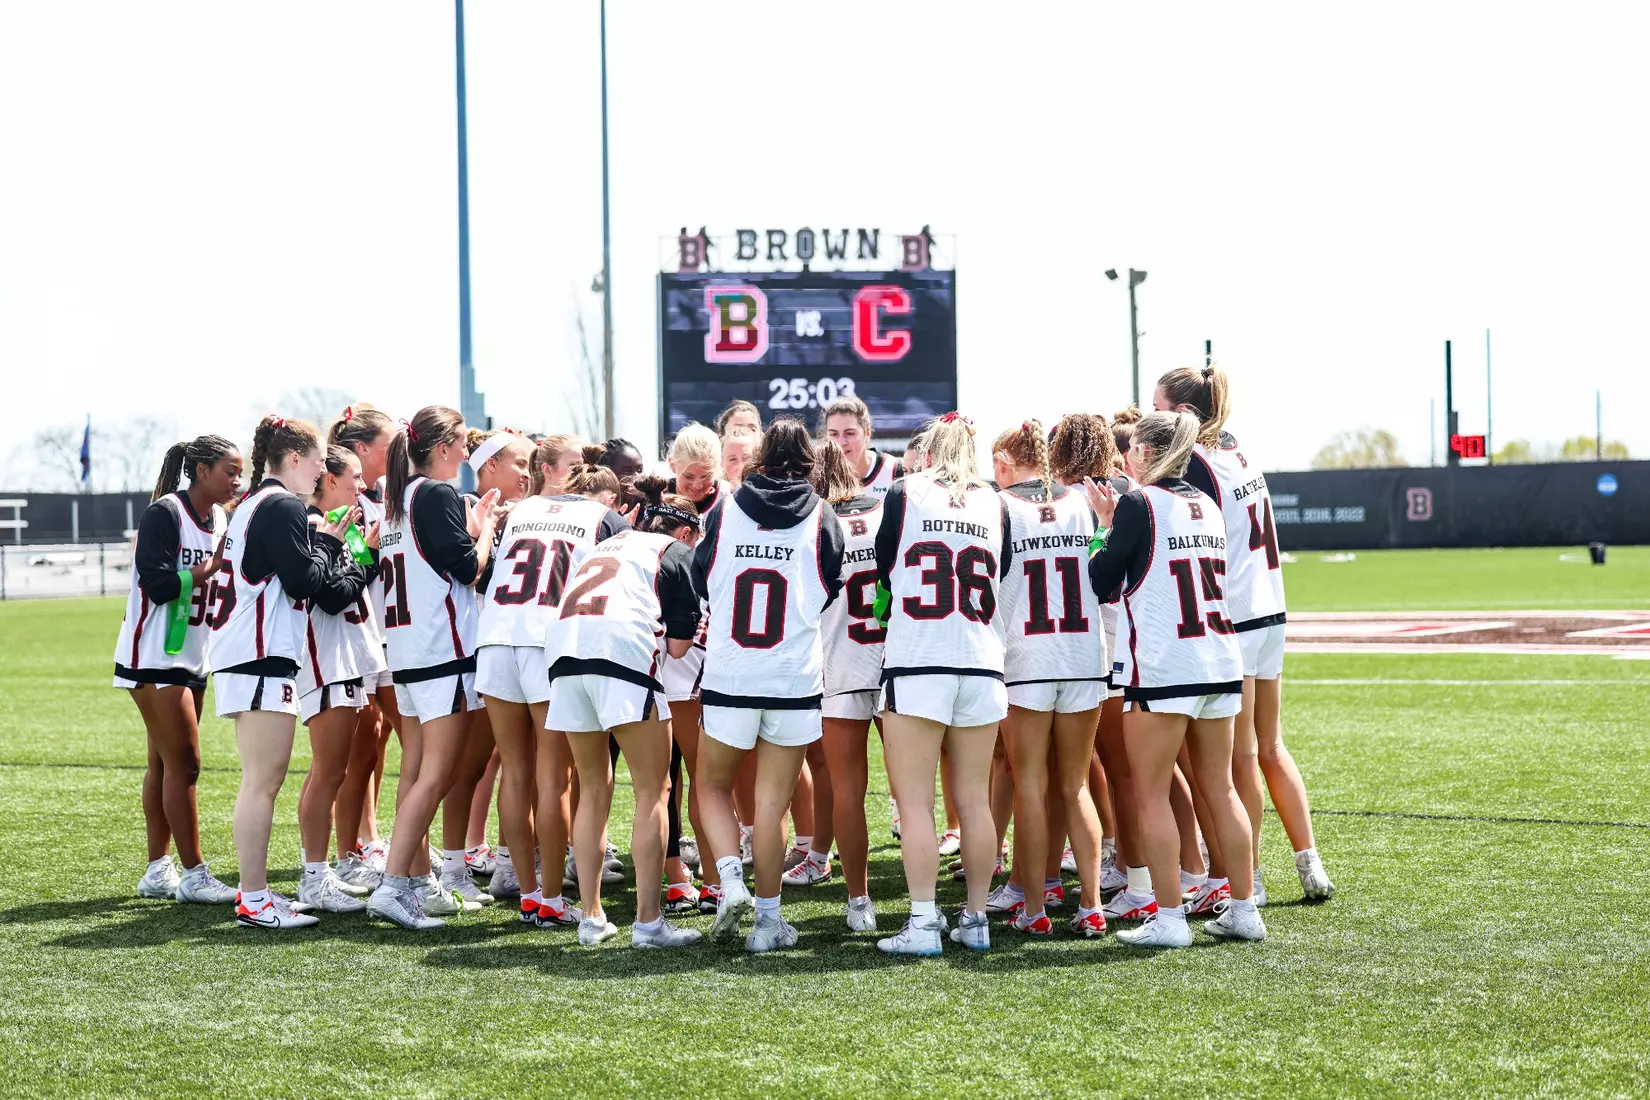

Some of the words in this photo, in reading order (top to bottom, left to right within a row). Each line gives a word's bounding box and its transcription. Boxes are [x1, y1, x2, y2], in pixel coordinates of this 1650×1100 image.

[735, 228, 880, 261] BROWN
[704, 285, 769, 363] B
[853, 284, 912, 362] C
[768, 377, 856, 410] 25:03
[511, 522, 586, 538] BONGIORNO
[848, 518, 869, 537] B
[922, 519, 989, 540] ROTHNIE
[1012, 534, 1092, 554] LIWKOWSK
[1167, 534, 1226, 551] BALKUNAS
[734, 544, 795, 561] KELLEY
[842, 547, 877, 565] MER
[493, 538, 576, 608] 31
[559, 556, 622, 620] 2
[903, 540, 998, 626] 36
[731, 567, 788, 649] 0
[1023, 556, 1089, 636] 11
[1168, 557, 1236, 639] 15
